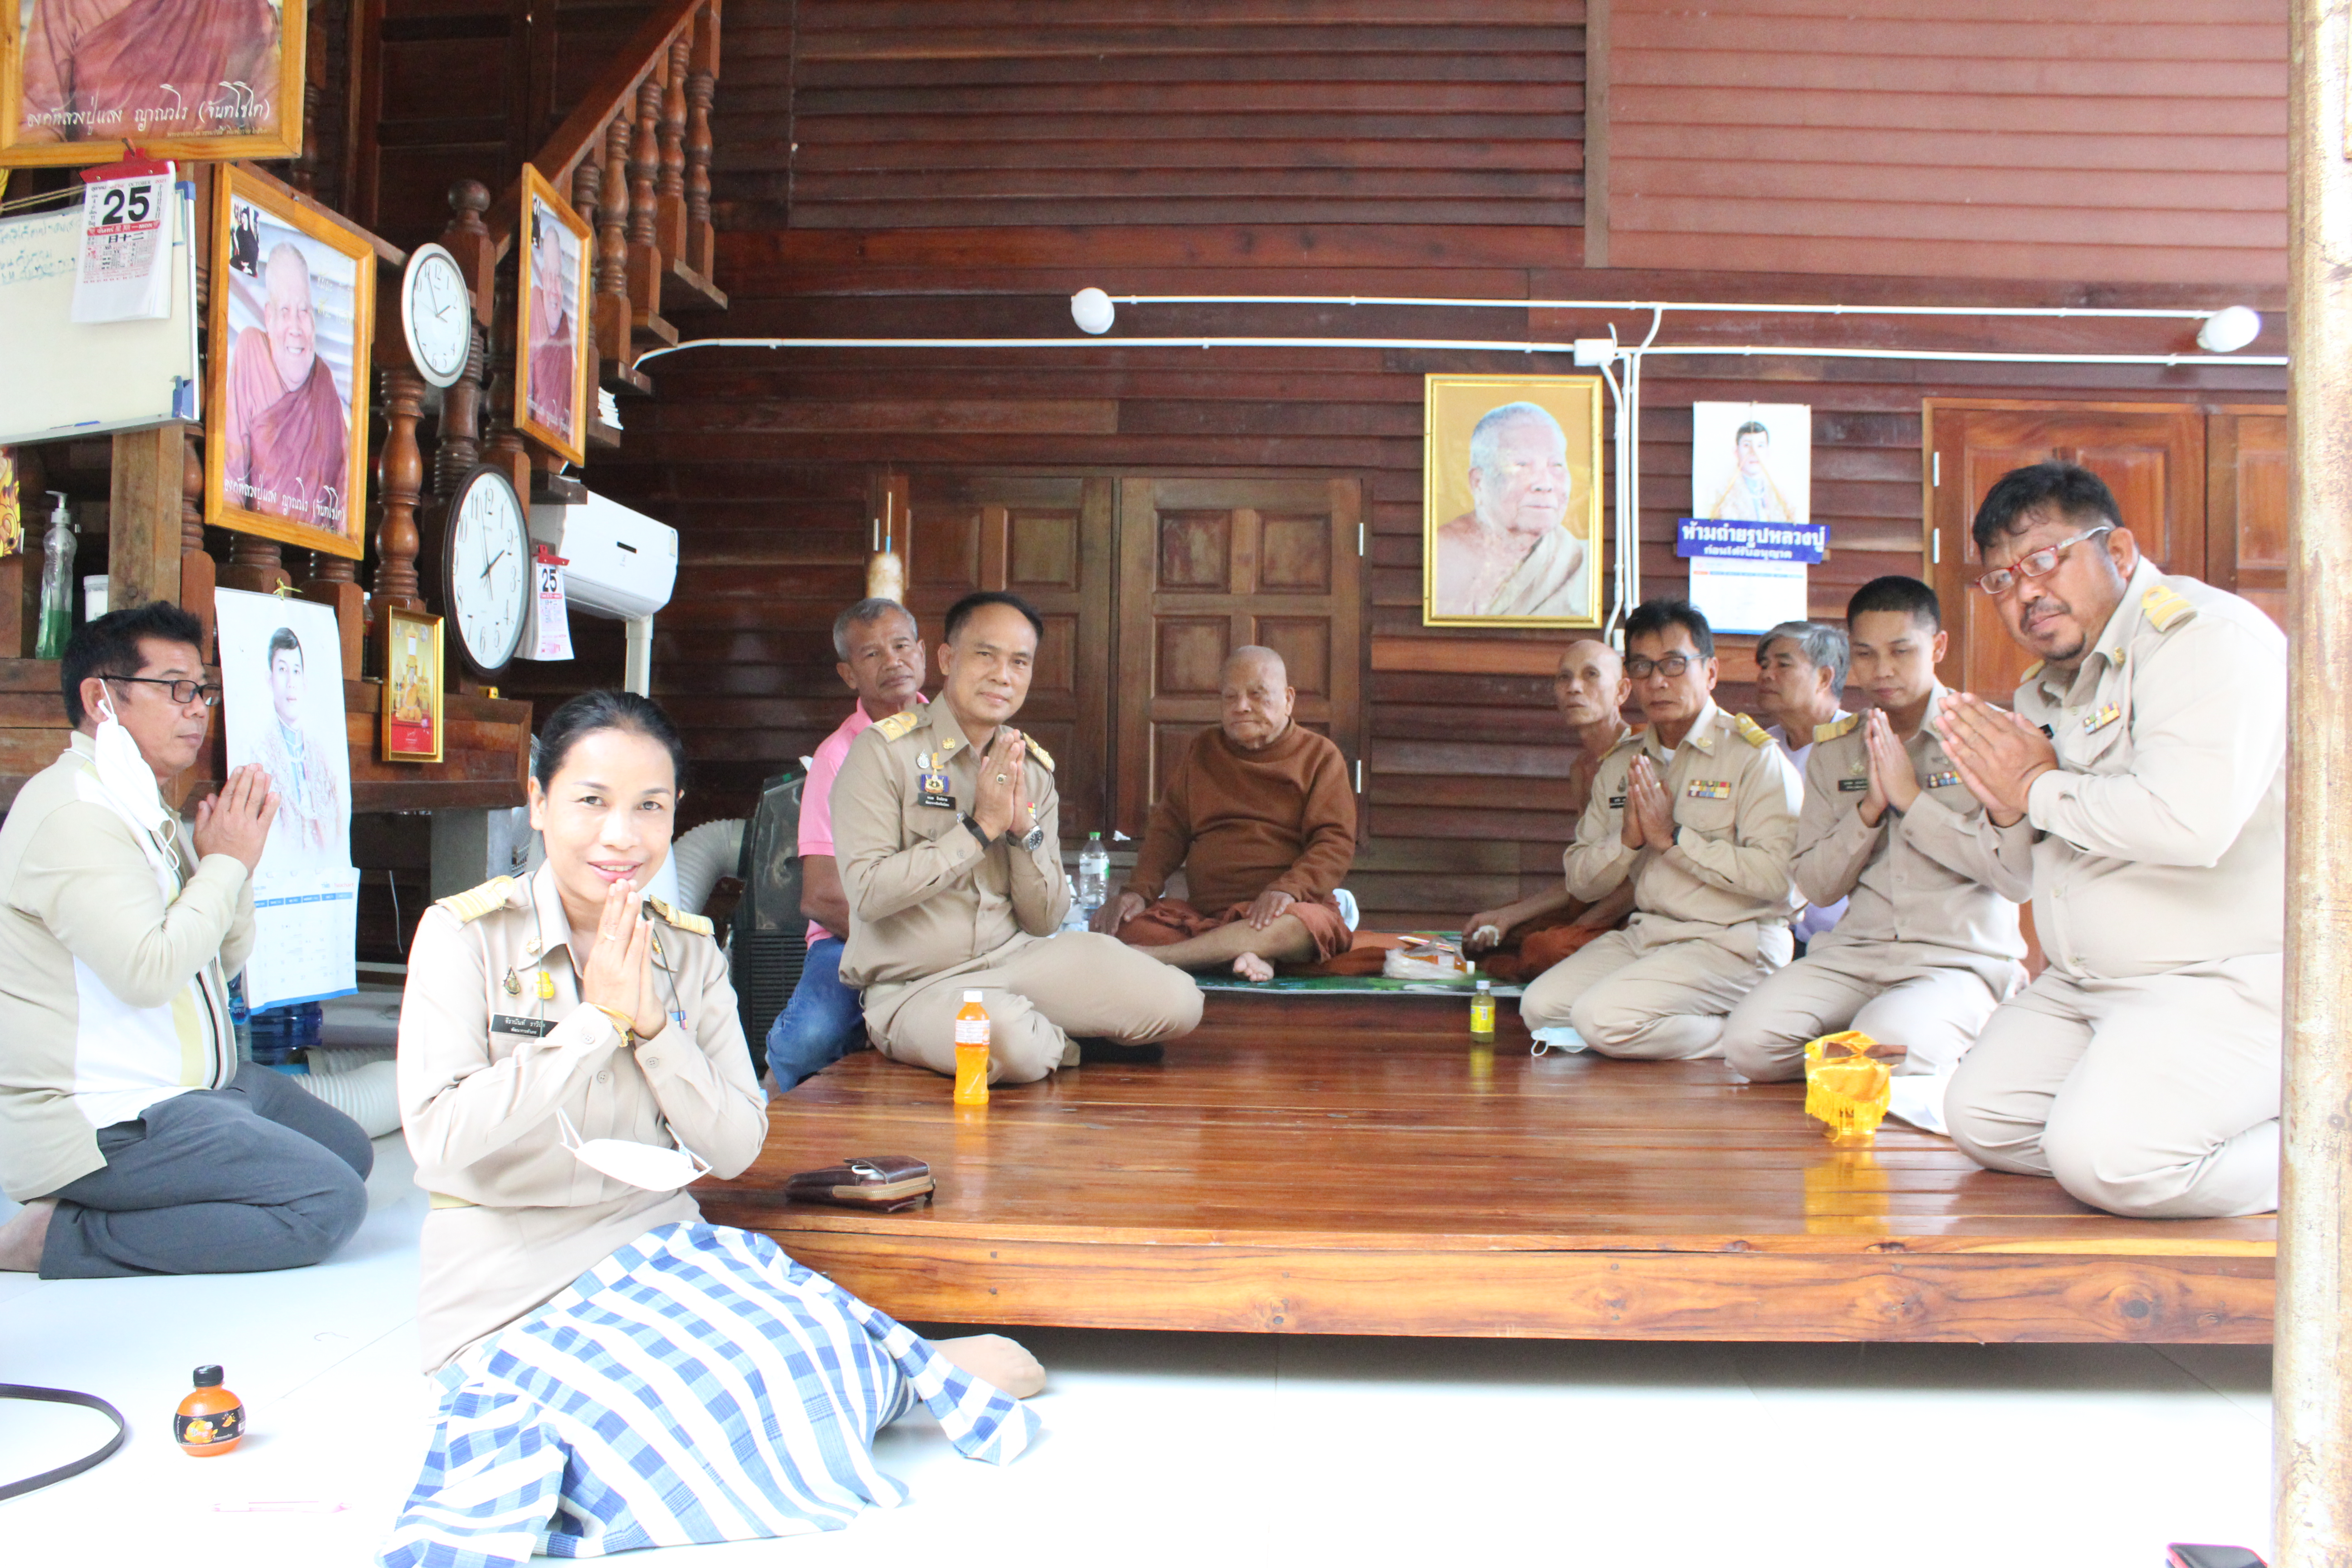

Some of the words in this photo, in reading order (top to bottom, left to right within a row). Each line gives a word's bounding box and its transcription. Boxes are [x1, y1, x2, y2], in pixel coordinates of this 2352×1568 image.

[102, 185, 151, 225] 25
[435, 264, 441, 280] 12
[432, 353, 436, 368] 6
[471, 491, 478, 520] 11
[485, 487, 494, 515] 12
[458, 514, 467, 543] 10
[1682, 520, 1825, 553] ห้ามถ่ายรูปหลวงปู่
[507, 529, 513, 556] 2
[1704, 544, 1793, 561] ก่อนได้รับอนุญาต
[510, 566, 516, 593] 3
[542, 568, 557, 593] 25
[456, 585, 463, 614] 8
[504, 599, 509, 626] 4
[467, 614, 473, 642] 7
[480, 626, 485, 654] 6
[494, 622, 500, 648] 5
